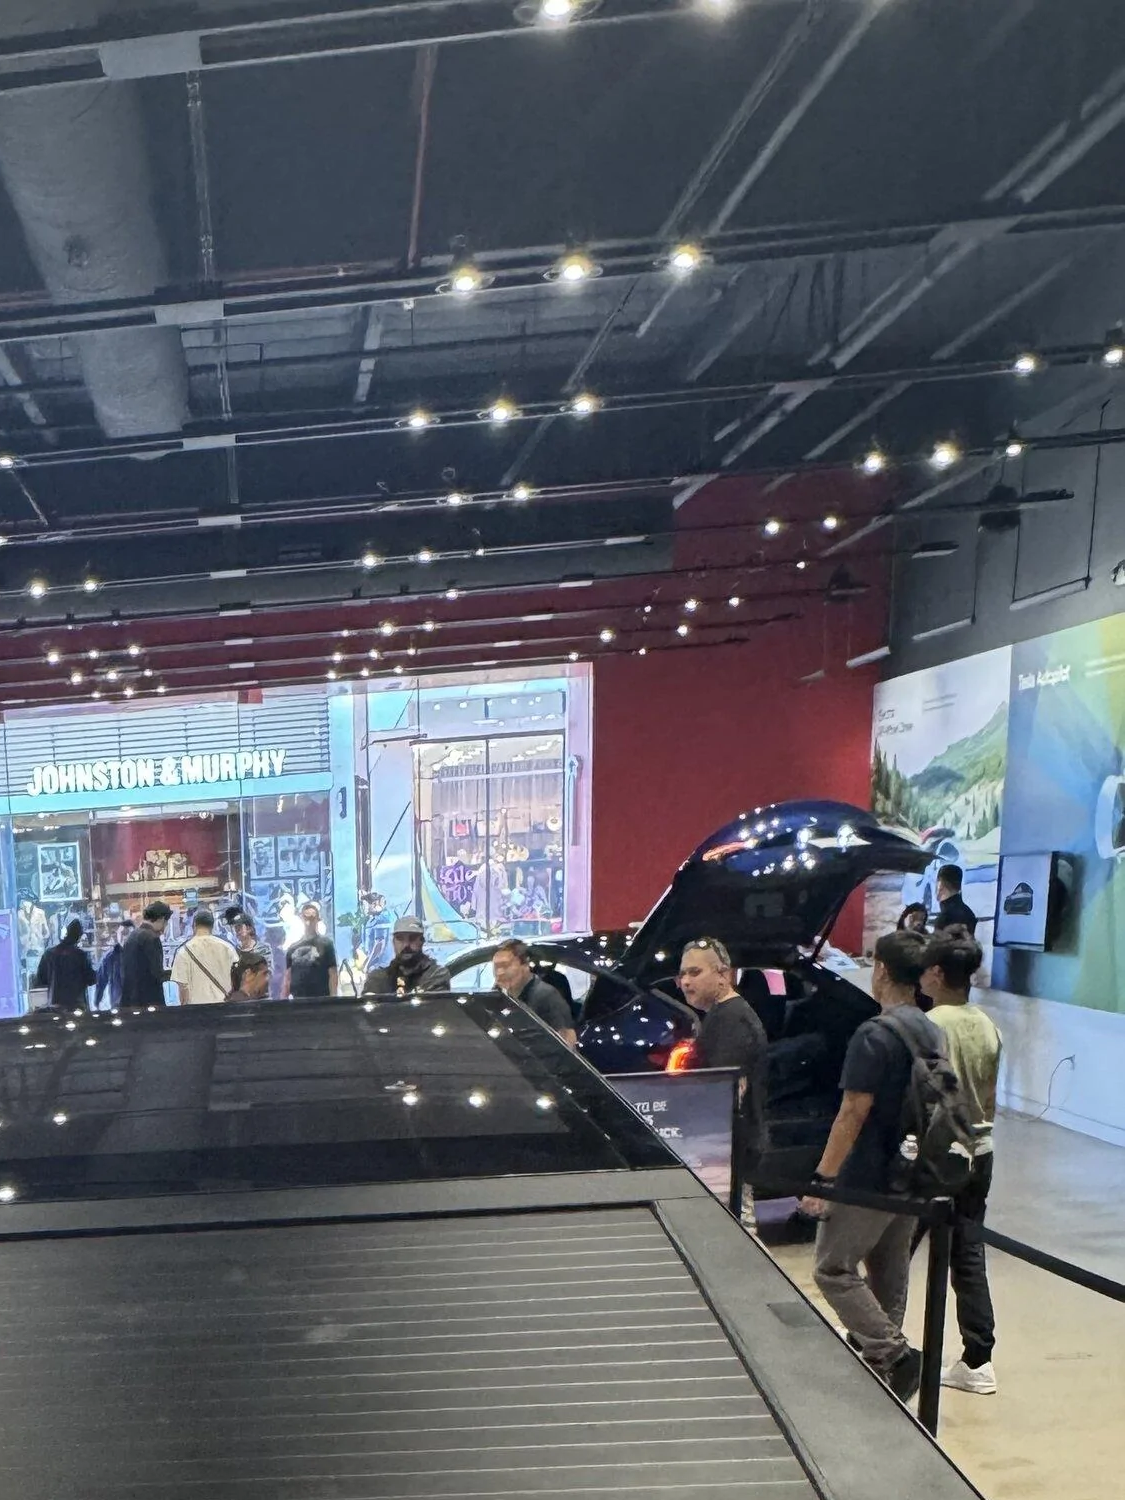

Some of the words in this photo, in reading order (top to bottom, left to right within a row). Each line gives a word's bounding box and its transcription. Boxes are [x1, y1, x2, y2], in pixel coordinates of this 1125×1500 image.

[27, 759, 155, 796] JOHNSTON
[160, 755, 179, 786] &
[181, 749, 287, 784] MURPHY
